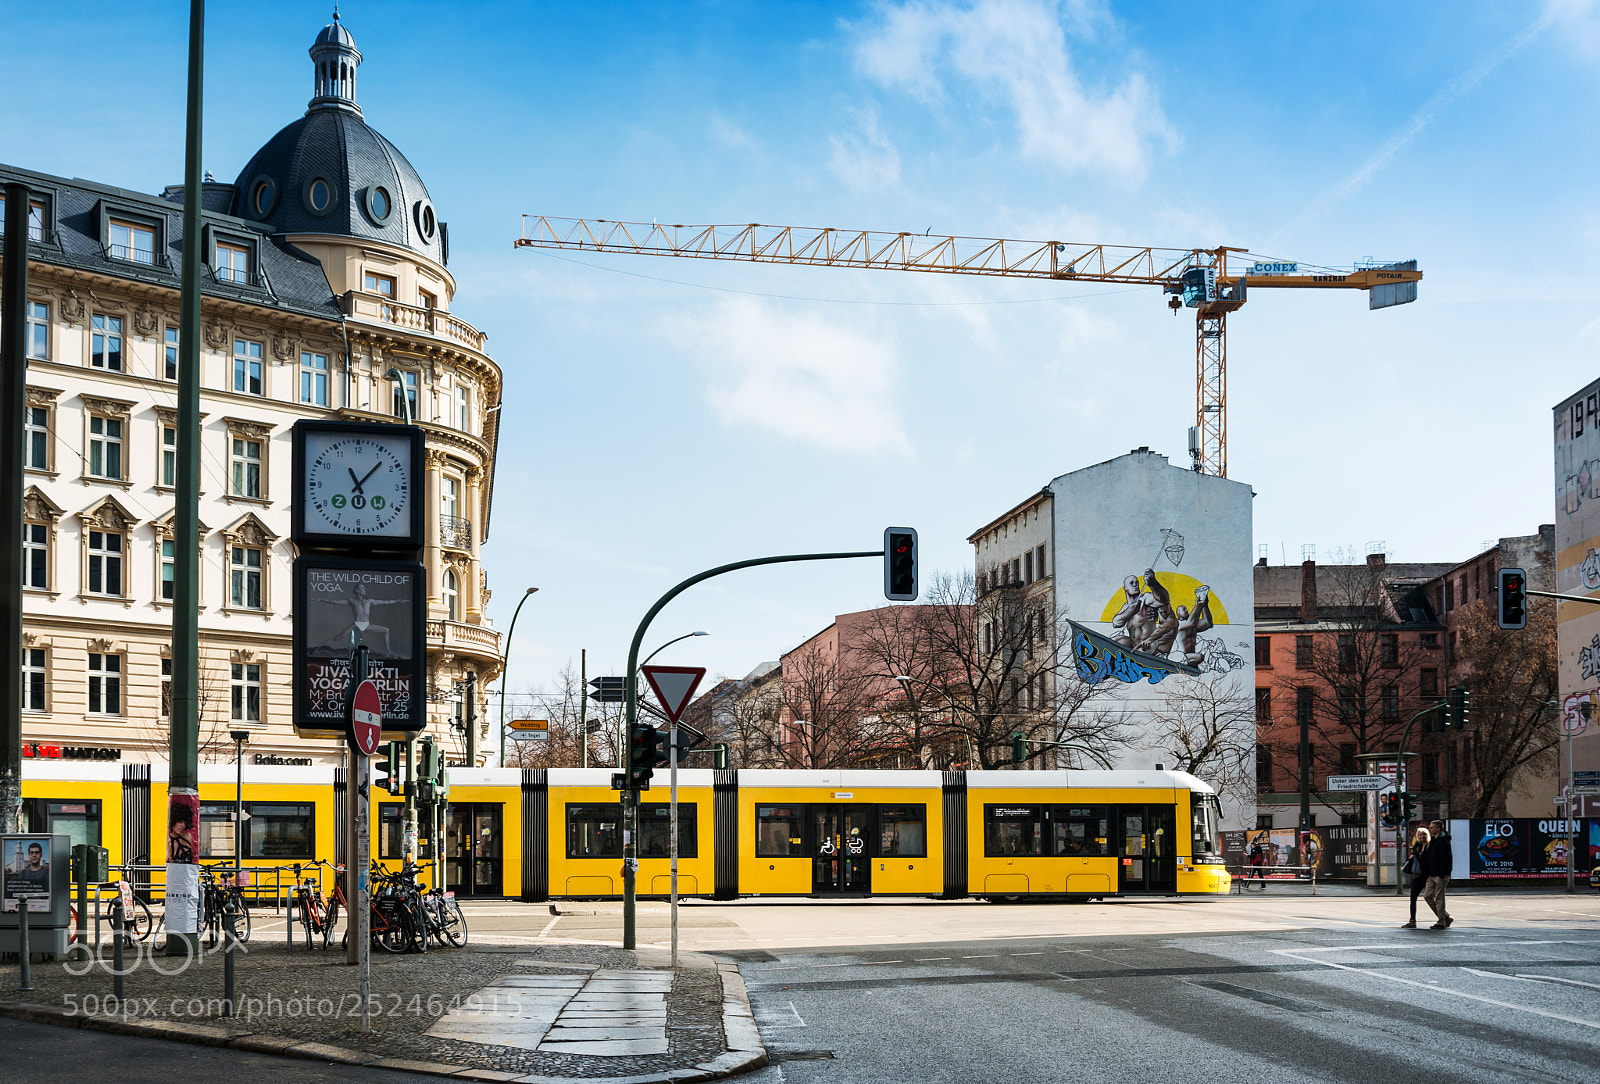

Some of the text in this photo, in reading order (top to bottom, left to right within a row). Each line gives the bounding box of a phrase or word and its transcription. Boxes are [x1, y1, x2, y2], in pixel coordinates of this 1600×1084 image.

[1254, 262, 1297, 272] CONEX
[1570, 388, 1600, 440] 199
[310, 572, 410, 585] THE WILD CHILD OF
[316, 666, 399, 679] JIVAUKTI
[310, 678, 351, 690] YOGA
[309, 689, 323, 700] M:
[395, 691, 410, 702] 29
[311, 700, 323, 710] X:
[393, 702, 408, 712] 25
[23, 743, 121, 760] LIVE NATION
[255, 753, 313, 766] Bolia.com
[1485, 824, 1514, 837] ELO
